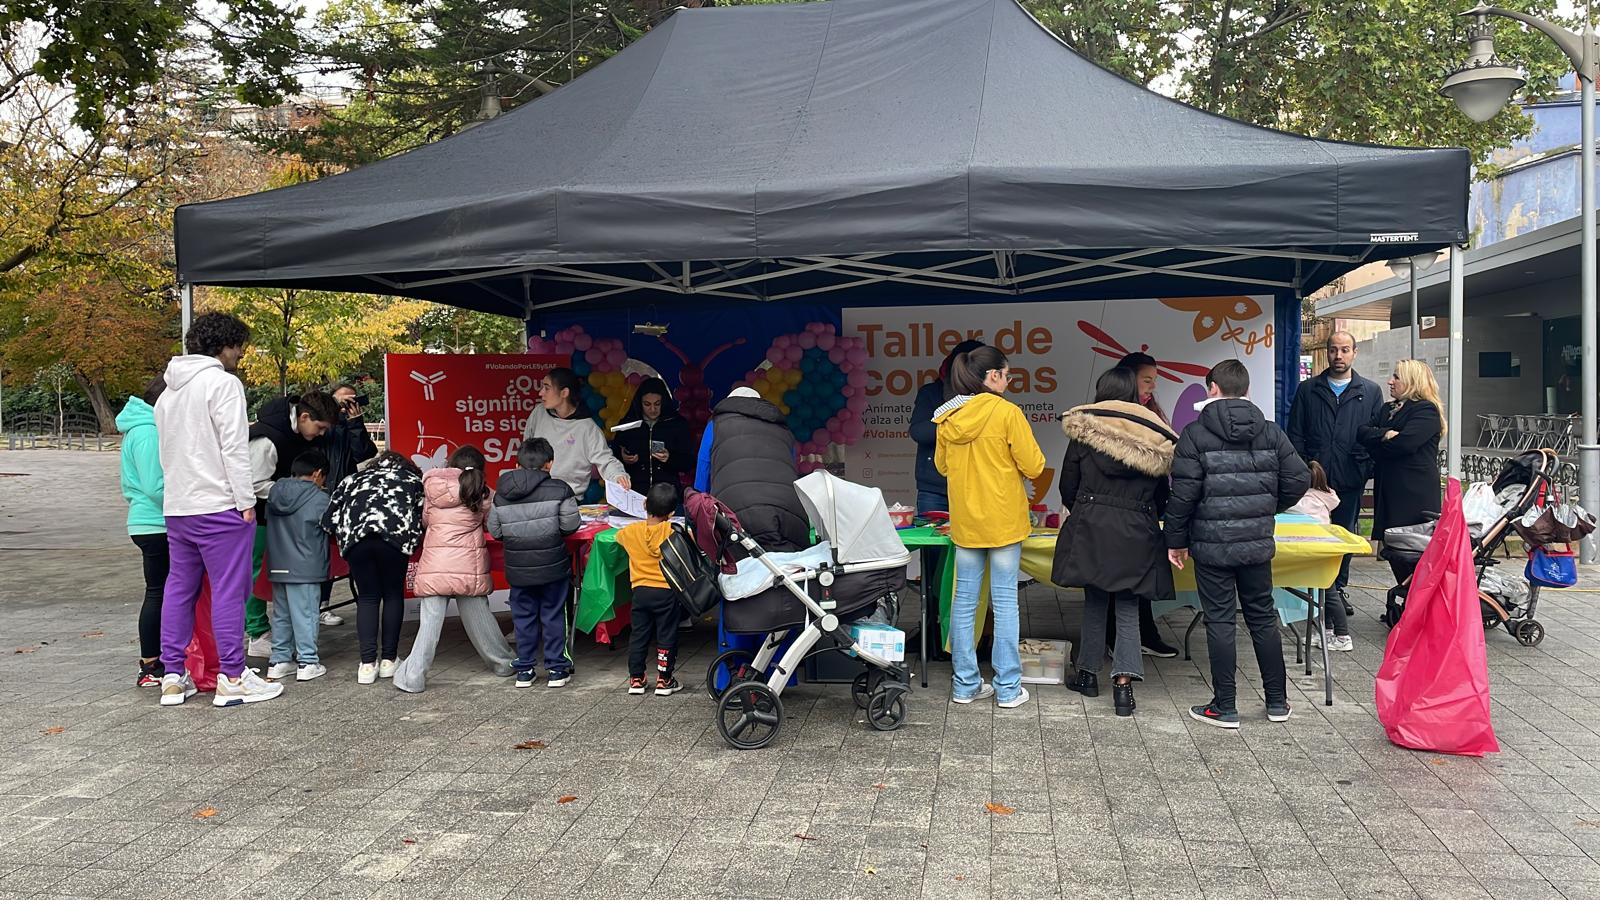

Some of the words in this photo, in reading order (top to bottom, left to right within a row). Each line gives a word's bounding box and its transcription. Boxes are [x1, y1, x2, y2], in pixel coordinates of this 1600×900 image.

[857, 323, 983, 358] Taller
[994, 320, 1053, 355] de
[506, 375, 544, 395] ¿Qu
[864, 366, 1058, 396] coas
[456, 395, 542, 416] signific
[862, 403, 912, 415] Anímate
[1018, 401, 1054, 411] ometa
[464, 416, 495, 432] las
[870, 415, 891, 425] alza
[893, 415, 904, 425] el
[483, 437, 521, 462] SA
